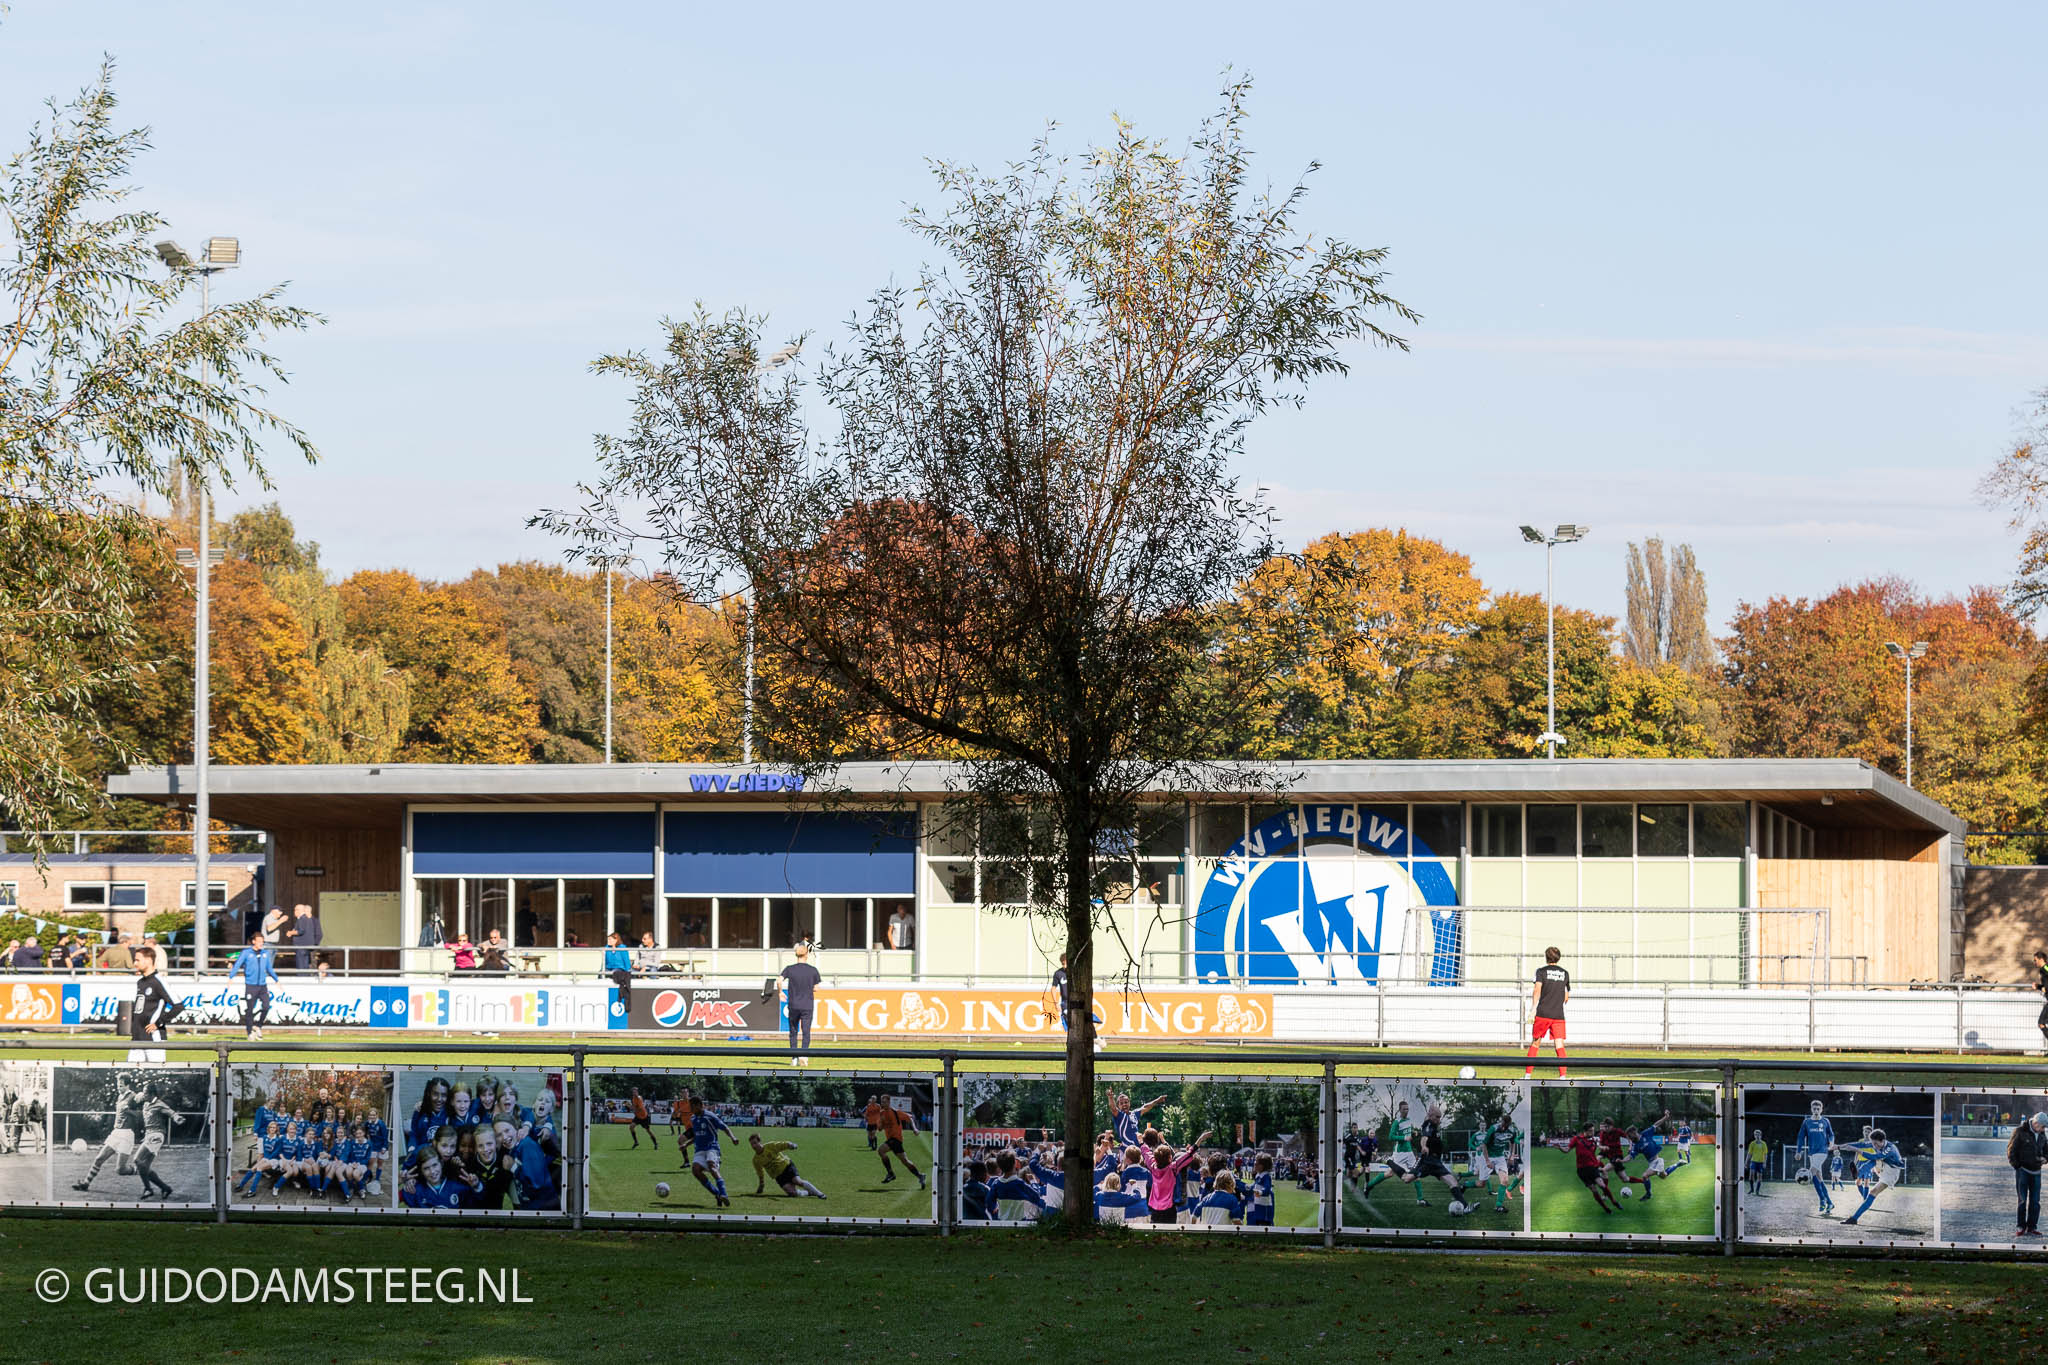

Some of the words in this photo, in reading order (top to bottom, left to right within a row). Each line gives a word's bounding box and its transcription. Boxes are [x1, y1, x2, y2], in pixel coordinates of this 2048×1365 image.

[689, 774, 806, 793] WV-HEDW
[1213, 807, 1404, 888] WV-HEDW
[693, 989, 720, 1000] pepsi
[300, 998, 362, 1018] man!
[686, 1000, 751, 1029] MAX
[811, 999, 889, 1031] ING
[961, 1000, 1045, 1032] ING
[1119, 1001, 1205, 1034] ING
